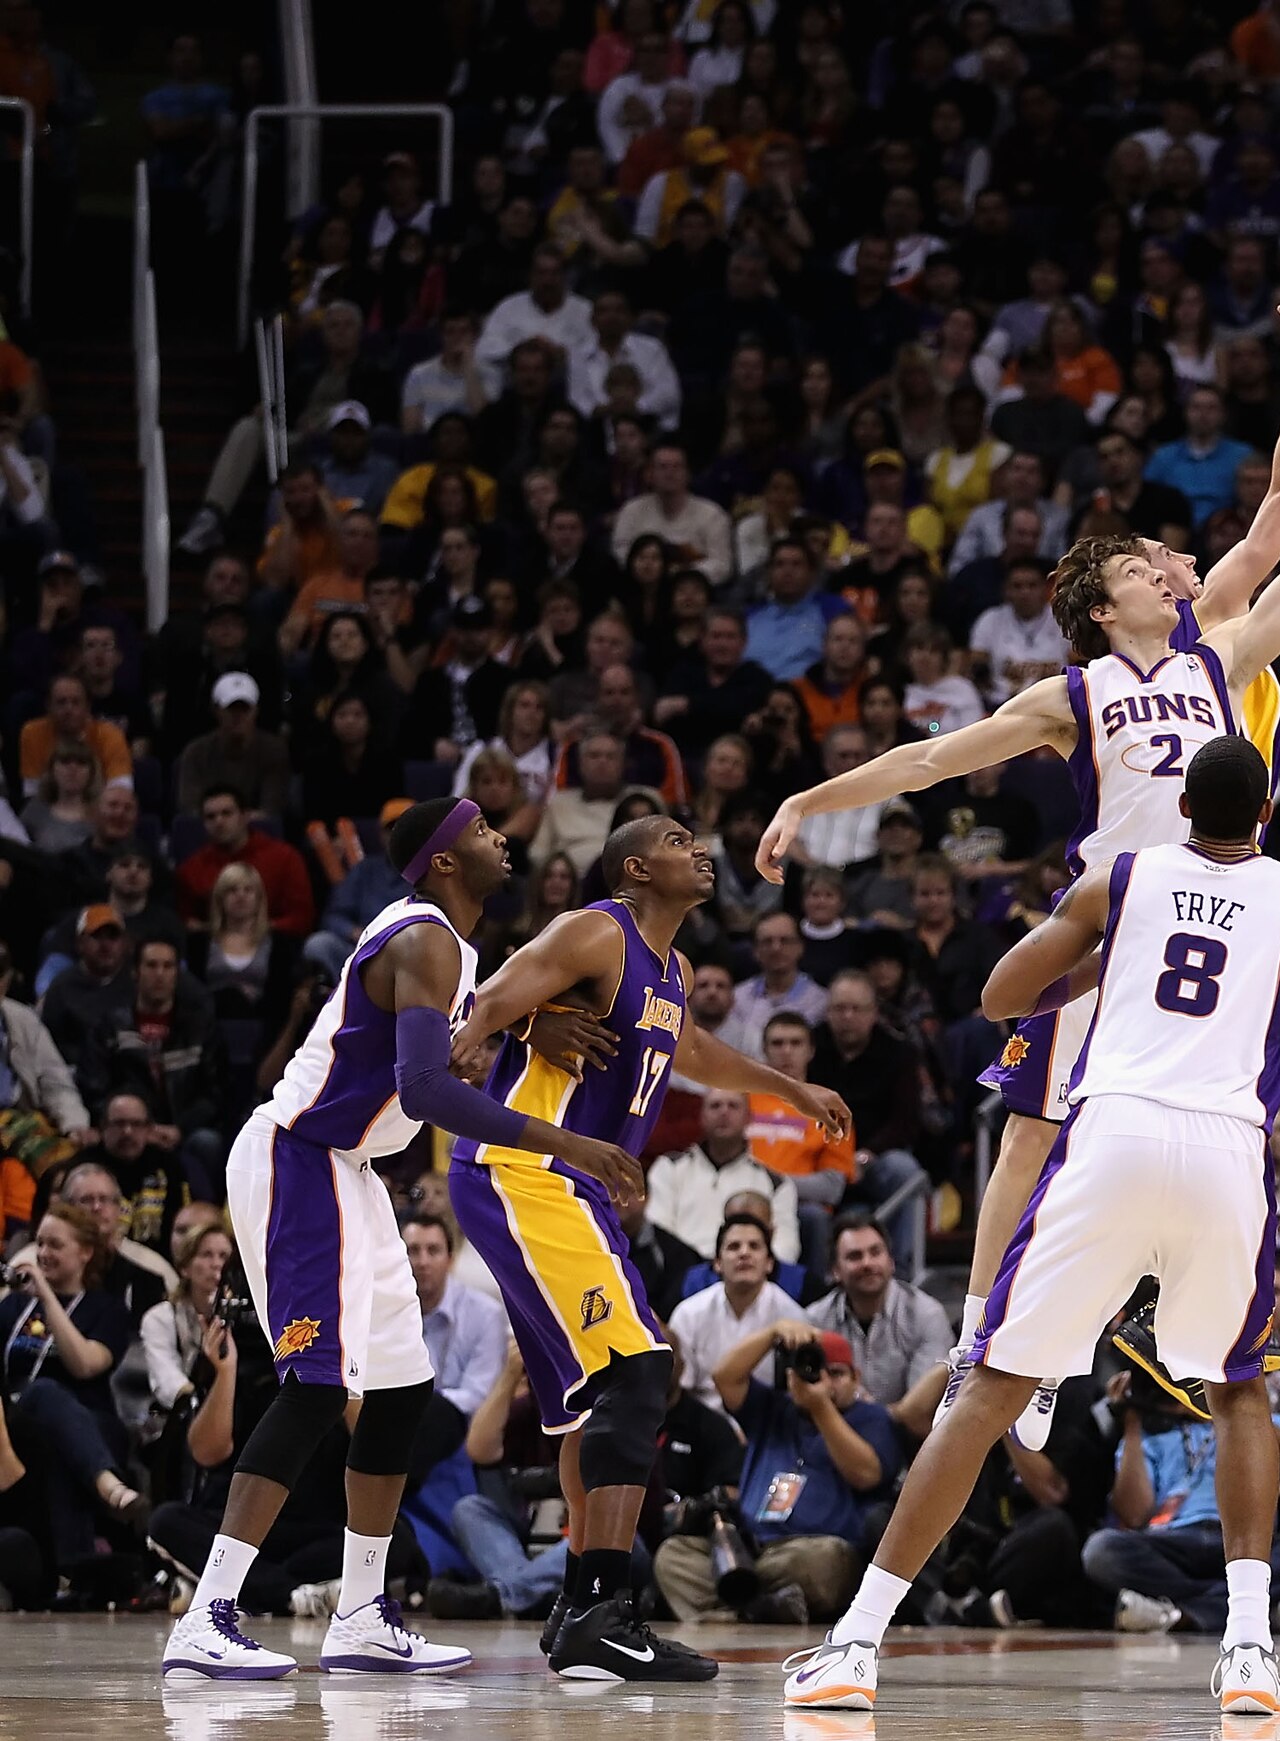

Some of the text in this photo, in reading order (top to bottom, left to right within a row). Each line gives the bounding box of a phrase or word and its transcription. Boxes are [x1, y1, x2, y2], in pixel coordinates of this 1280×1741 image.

[1101, 692, 1217, 742] SUNS
[1149, 732, 1186, 778] 2
[1171, 890, 1246, 932] FRYE
[1155, 931, 1229, 1018] 8
[628, 1047, 671, 1118] 17
